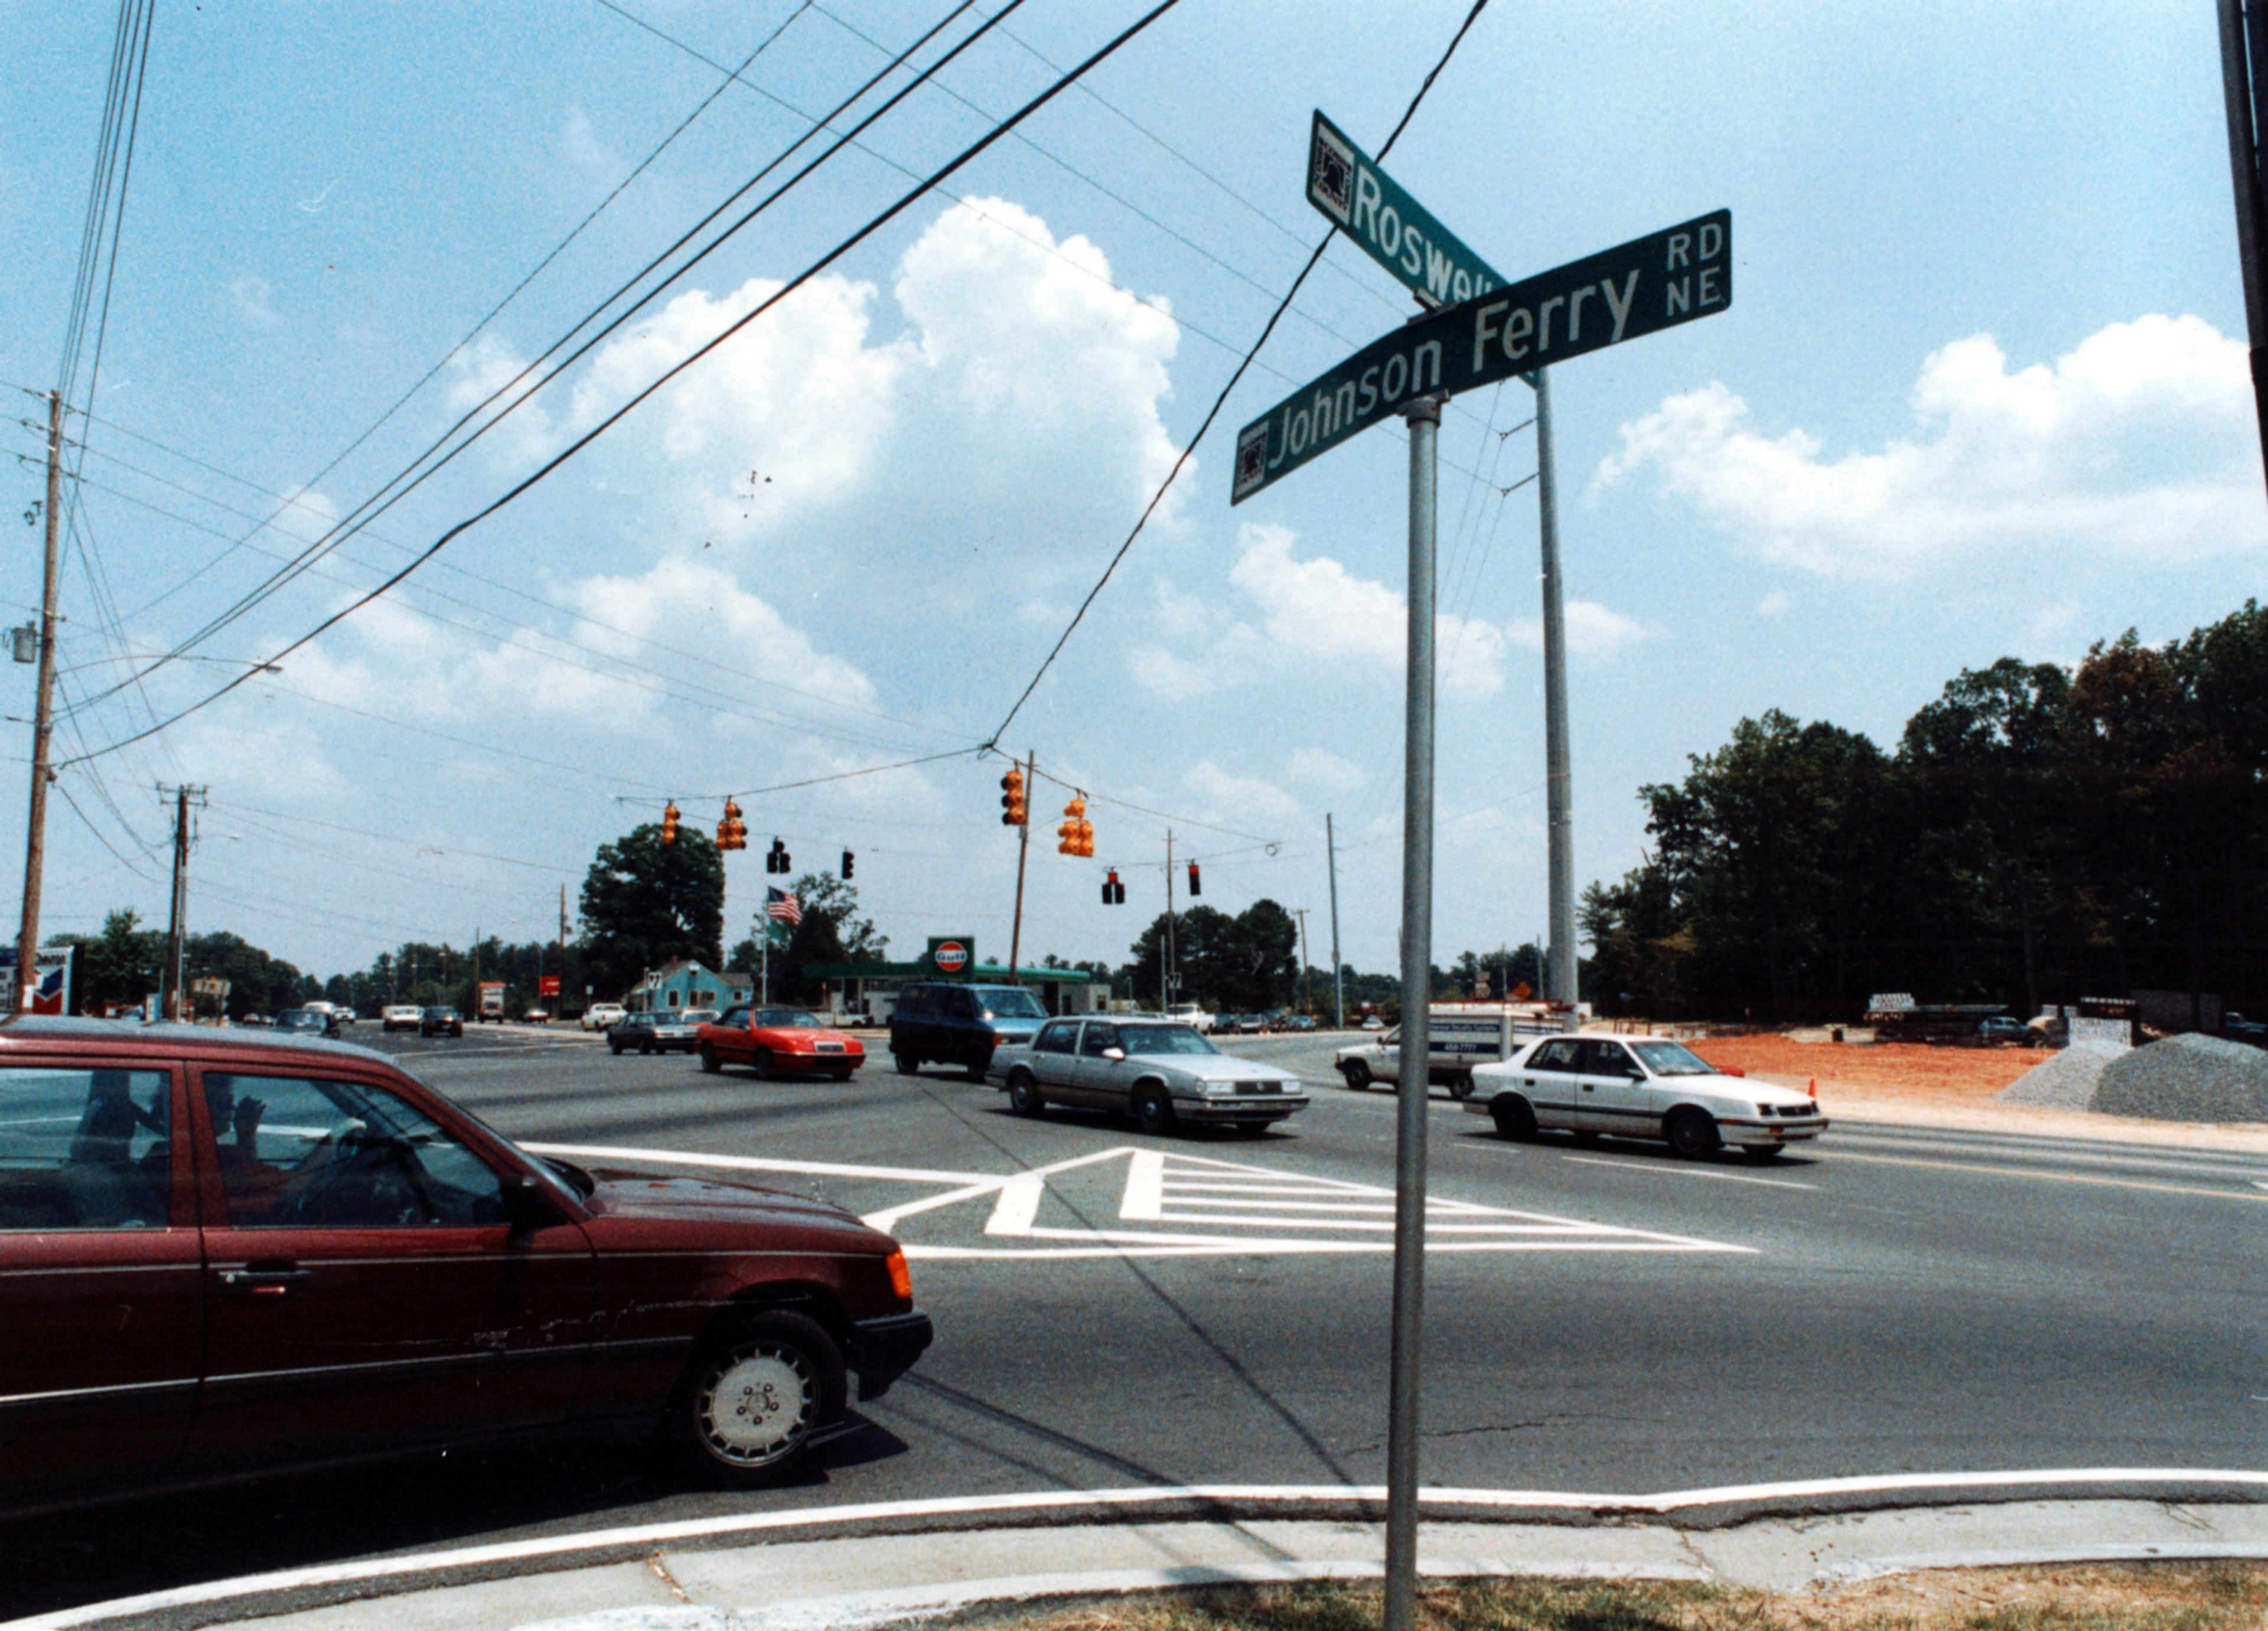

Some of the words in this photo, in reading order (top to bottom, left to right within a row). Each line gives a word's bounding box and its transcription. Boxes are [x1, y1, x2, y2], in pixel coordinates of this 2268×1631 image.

[1354, 163, 1492, 302] Roswe
[1667, 223, 1723, 272] RD
[1667, 266, 1721, 318] NE
[1268, 340, 1442, 469] Johnson
[1473, 269, 1641, 374] Ferry
[937, 951, 966, 962] Gulf
